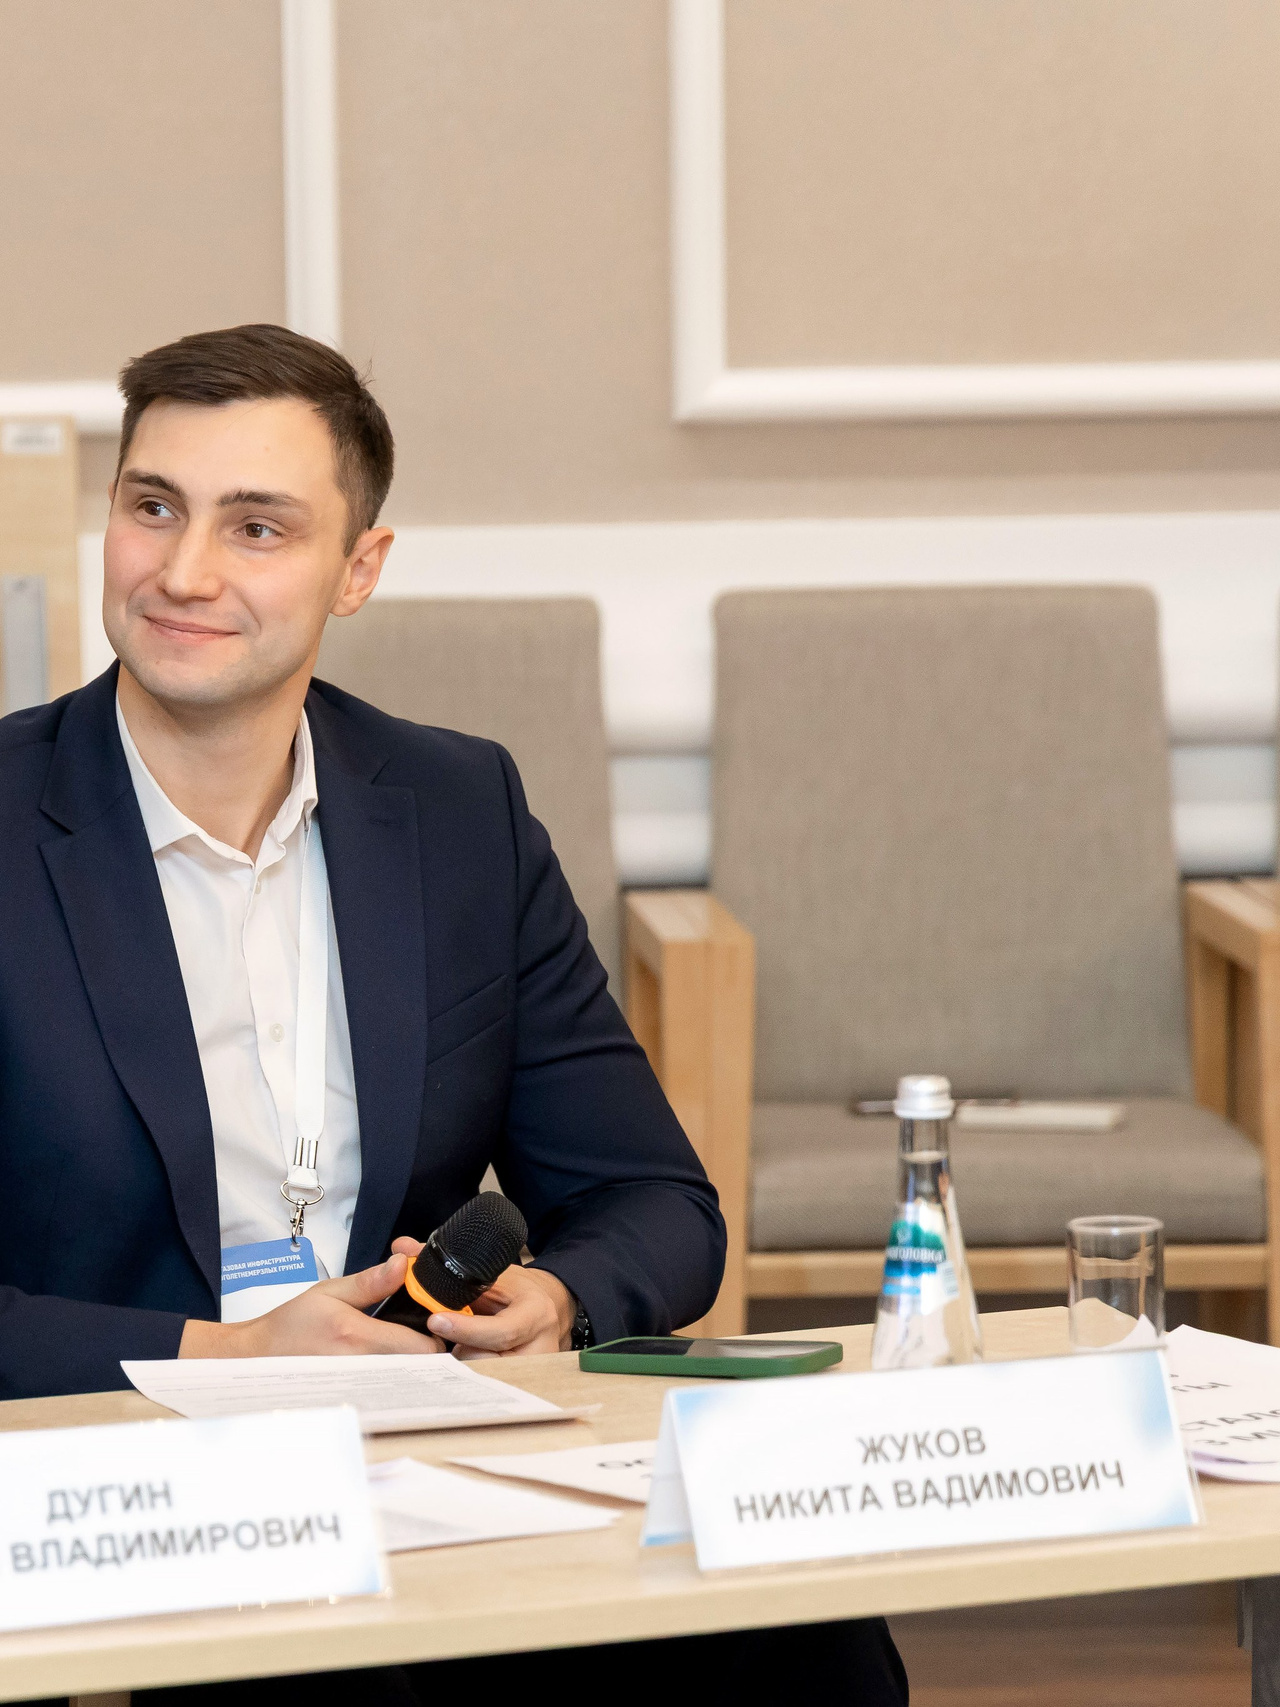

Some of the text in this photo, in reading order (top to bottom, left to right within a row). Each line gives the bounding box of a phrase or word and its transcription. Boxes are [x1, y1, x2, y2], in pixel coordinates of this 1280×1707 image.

[222, 1254, 301, 1272] АЗОВАЯ ИНФРАСТРУКТУРА
[278, 1262, 305, 1272] ГРУНТАХ
[859, 1427, 986, 1464] ЖУКОВ
[48, 1482, 171, 1523] ДУГИН
[735, 1461, 1125, 1522] НИКИТА ВАДИМОВИЧ
[10, 1515, 341, 1573] ВЛАДИМИРОВИЧ
